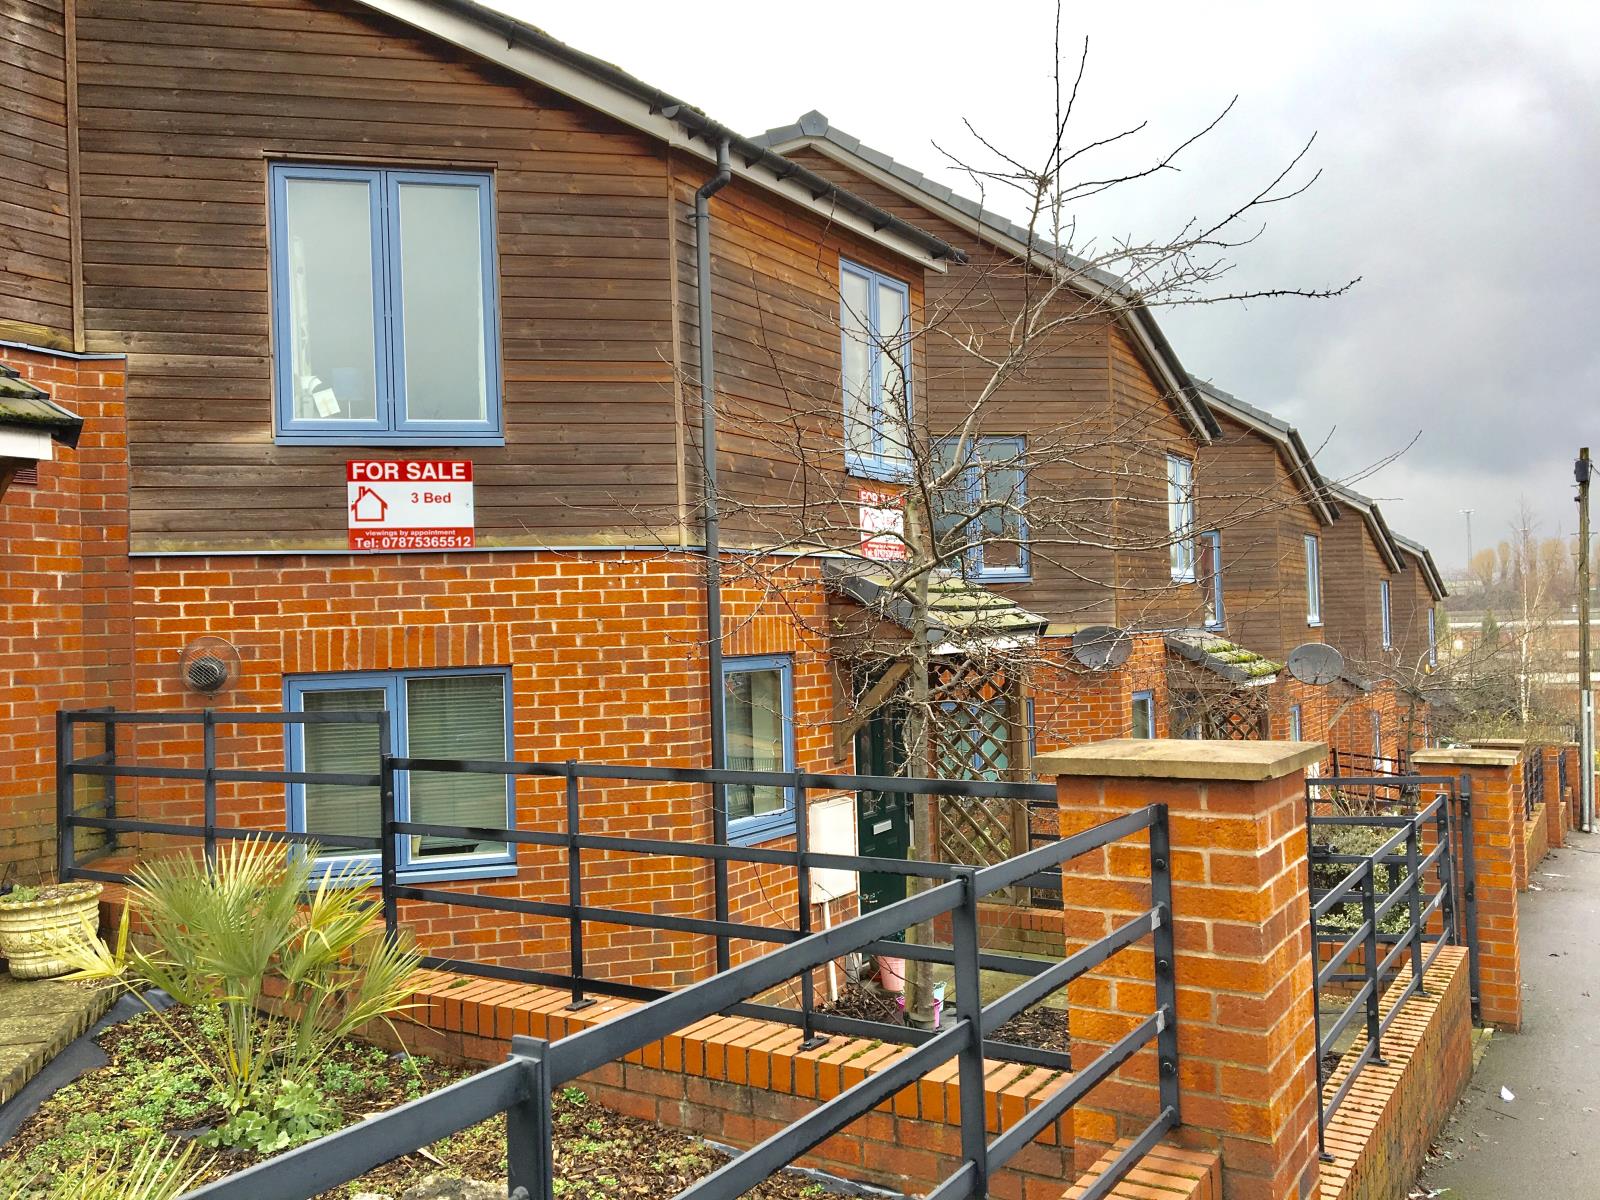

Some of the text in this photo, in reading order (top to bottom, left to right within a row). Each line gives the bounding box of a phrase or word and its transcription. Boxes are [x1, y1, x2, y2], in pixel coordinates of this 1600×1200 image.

[352, 462, 466, 480] FOR SALE
[411, 492, 452, 504] 3 Bed
[355, 536, 471, 548] Tel: 07875365512
